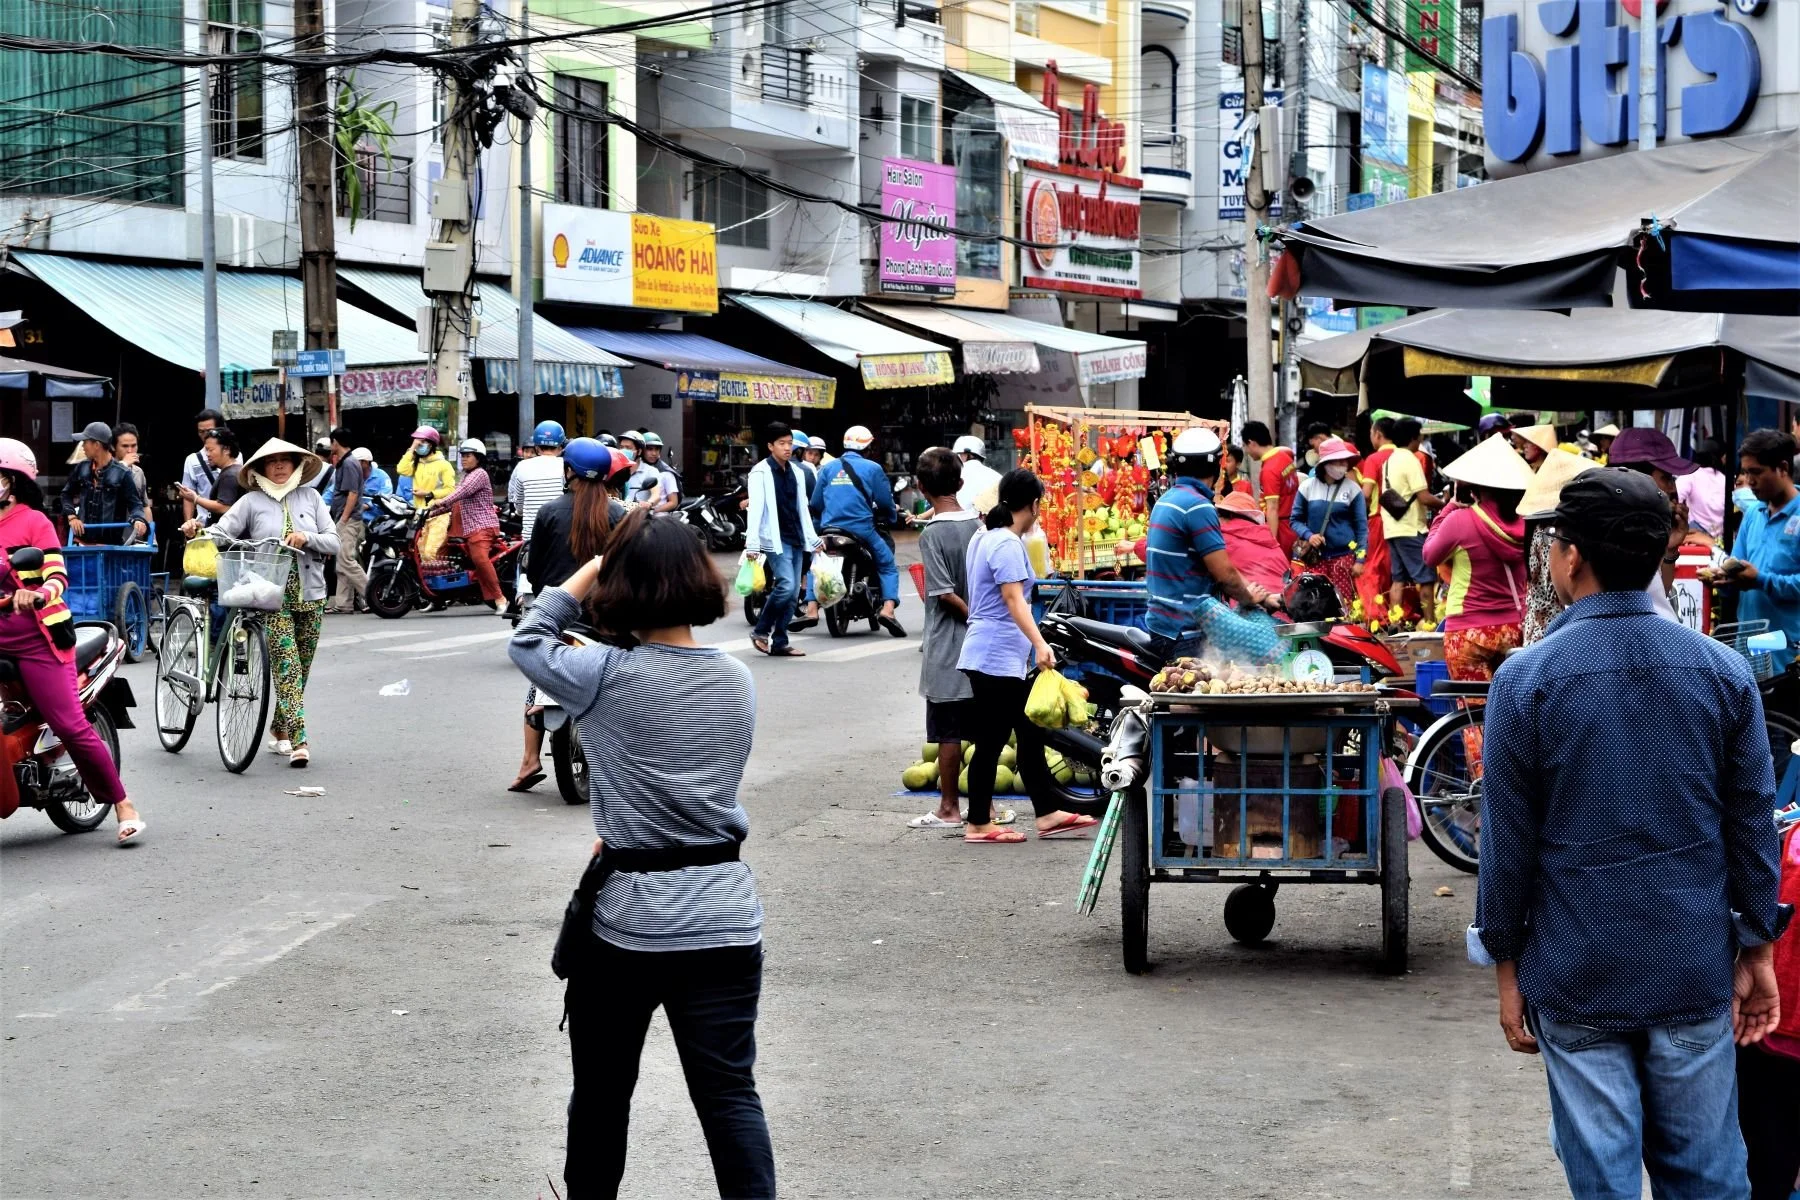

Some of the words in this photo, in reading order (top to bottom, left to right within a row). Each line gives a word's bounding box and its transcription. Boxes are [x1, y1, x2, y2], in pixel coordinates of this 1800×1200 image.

[887, 166, 902, 183] Hair
[903, 168, 924, 187] Salon
[650, 220, 661, 238] Xe
[578, 246, 624, 267] ADVANCE
[635, 240, 685, 273] HOÀNG
[885, 258, 905, 277] Phong
[25, 329, 44, 344] 31
[720, 379, 750, 397] HONDA
